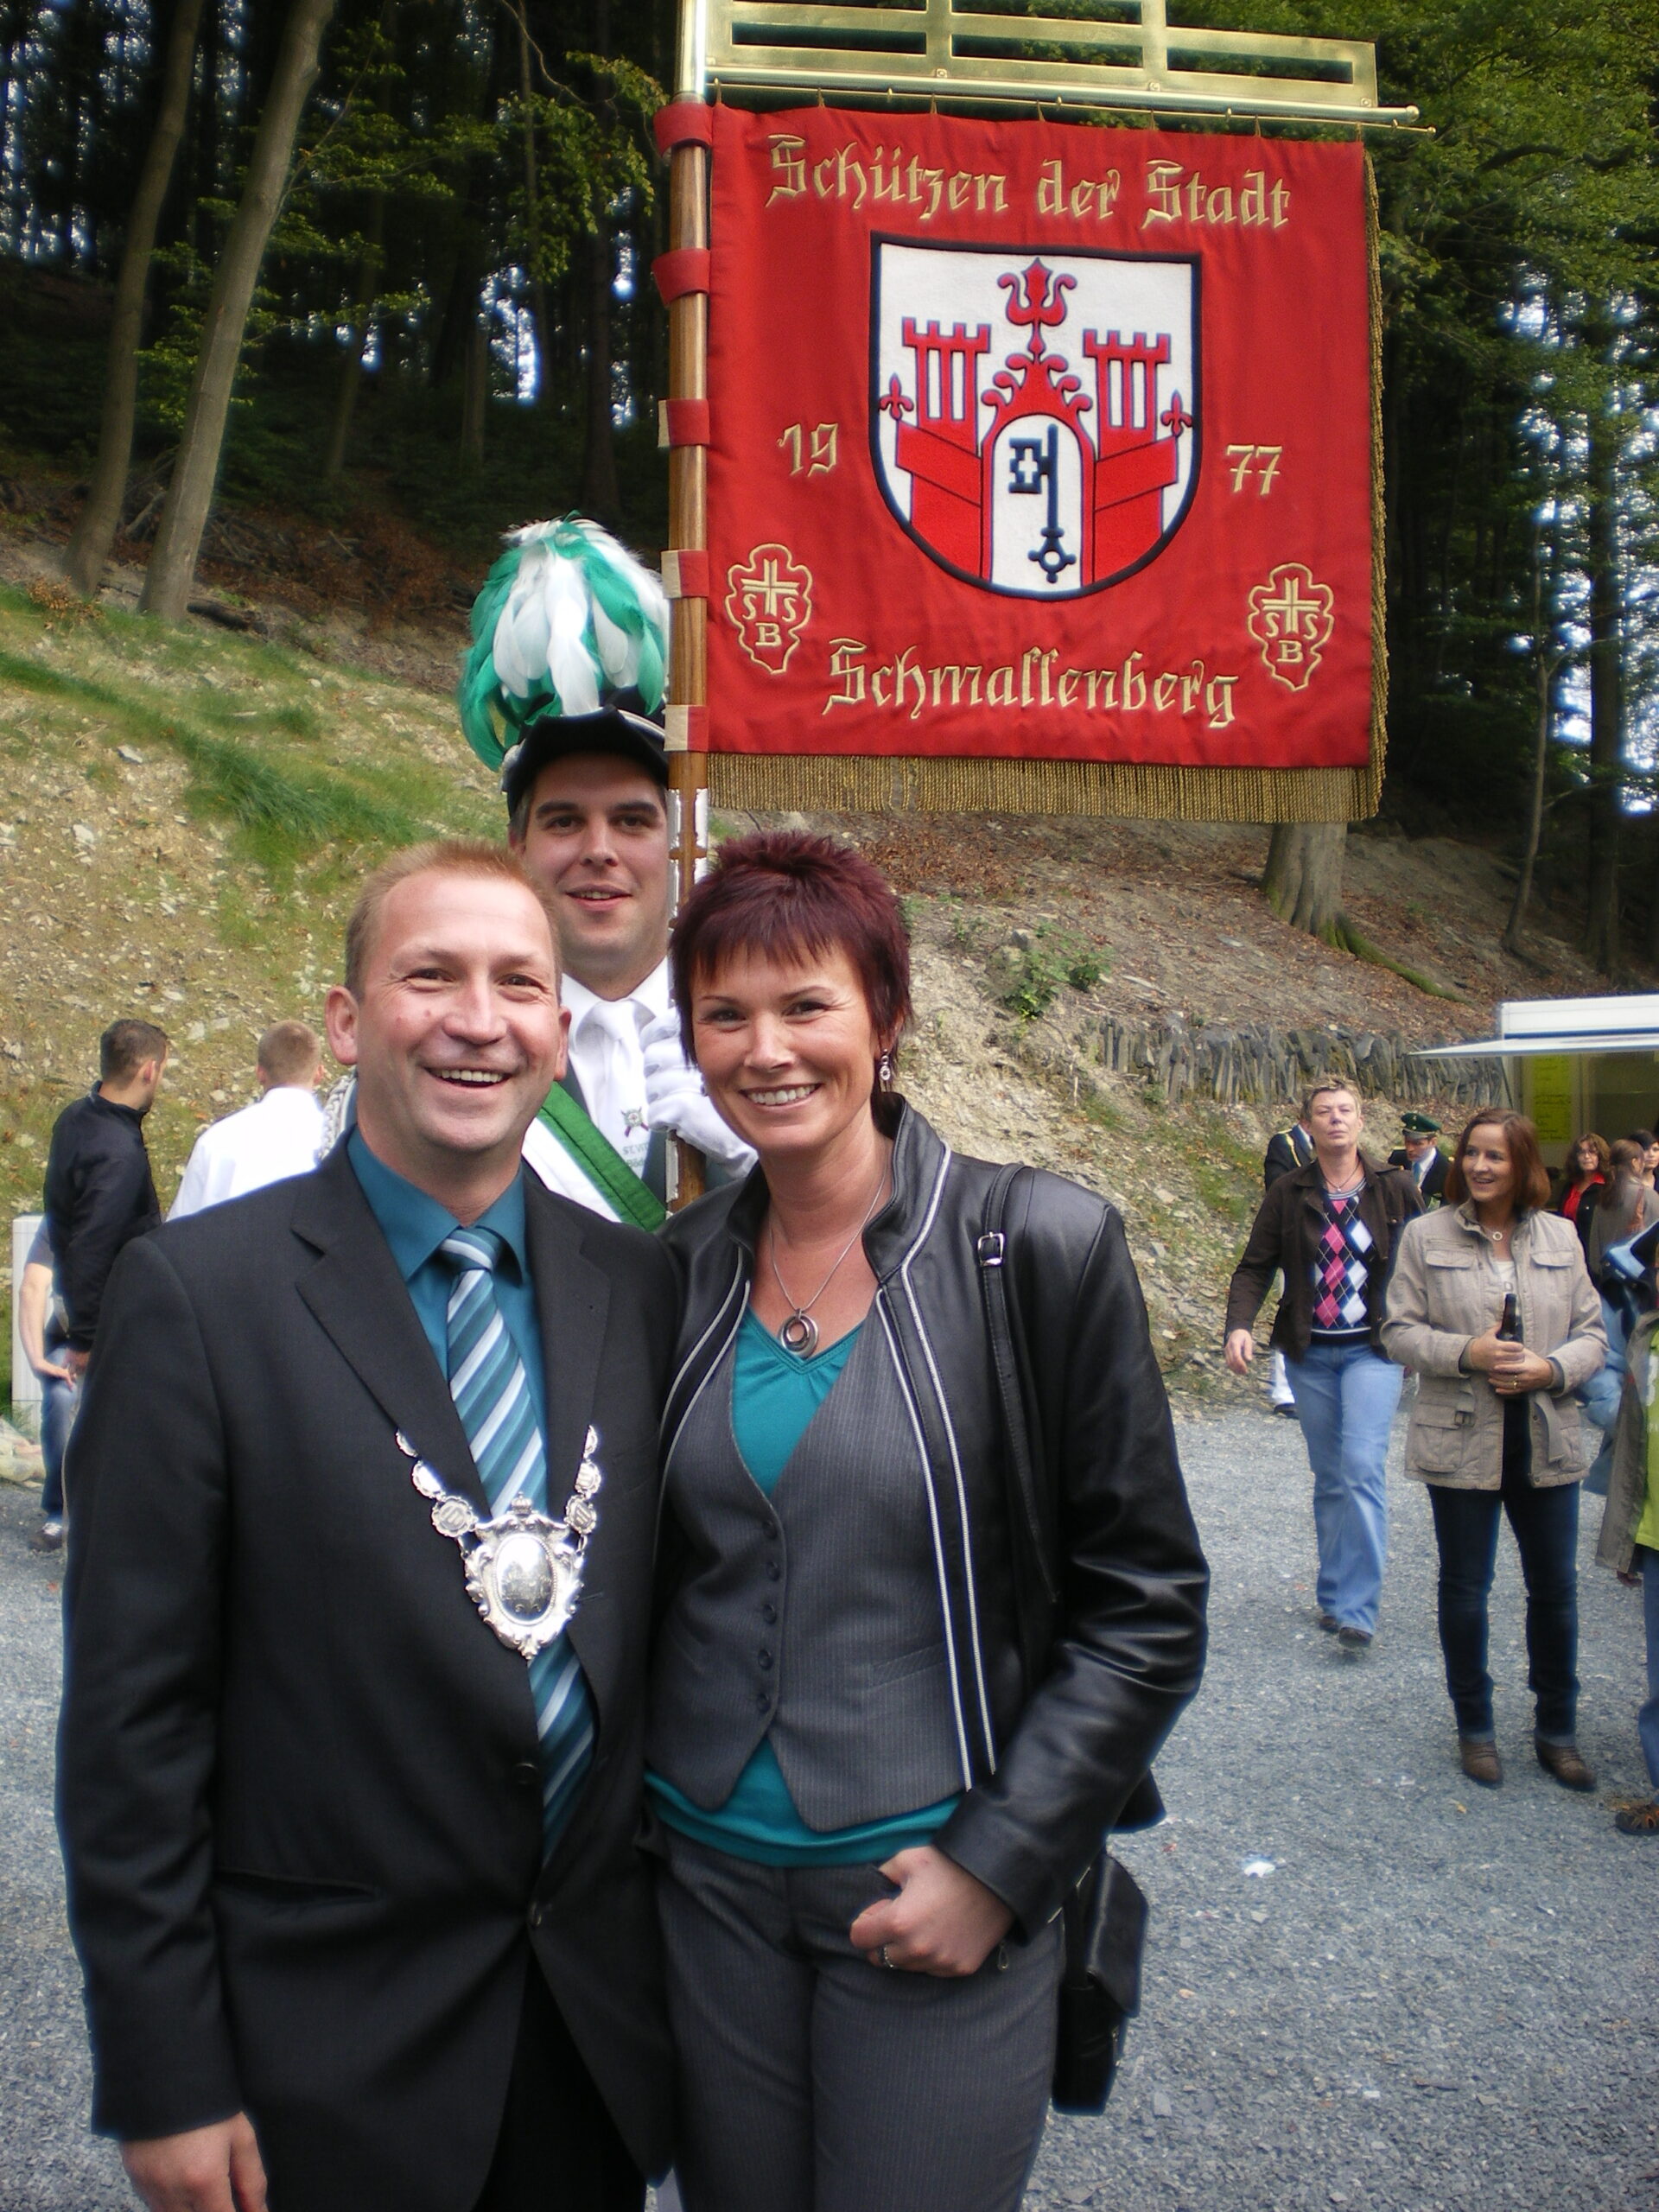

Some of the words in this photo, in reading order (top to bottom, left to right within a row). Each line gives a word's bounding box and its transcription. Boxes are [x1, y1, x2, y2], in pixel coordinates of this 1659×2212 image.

[766, 133, 1009, 221] Schützen
[1036, 158, 1122, 220] der
[1141, 158, 1291, 230] Stadt
[777, 422, 839, 478] 19
[1224, 443, 1283, 496] 77
[822, 638, 1239, 729] Schmallenberg
